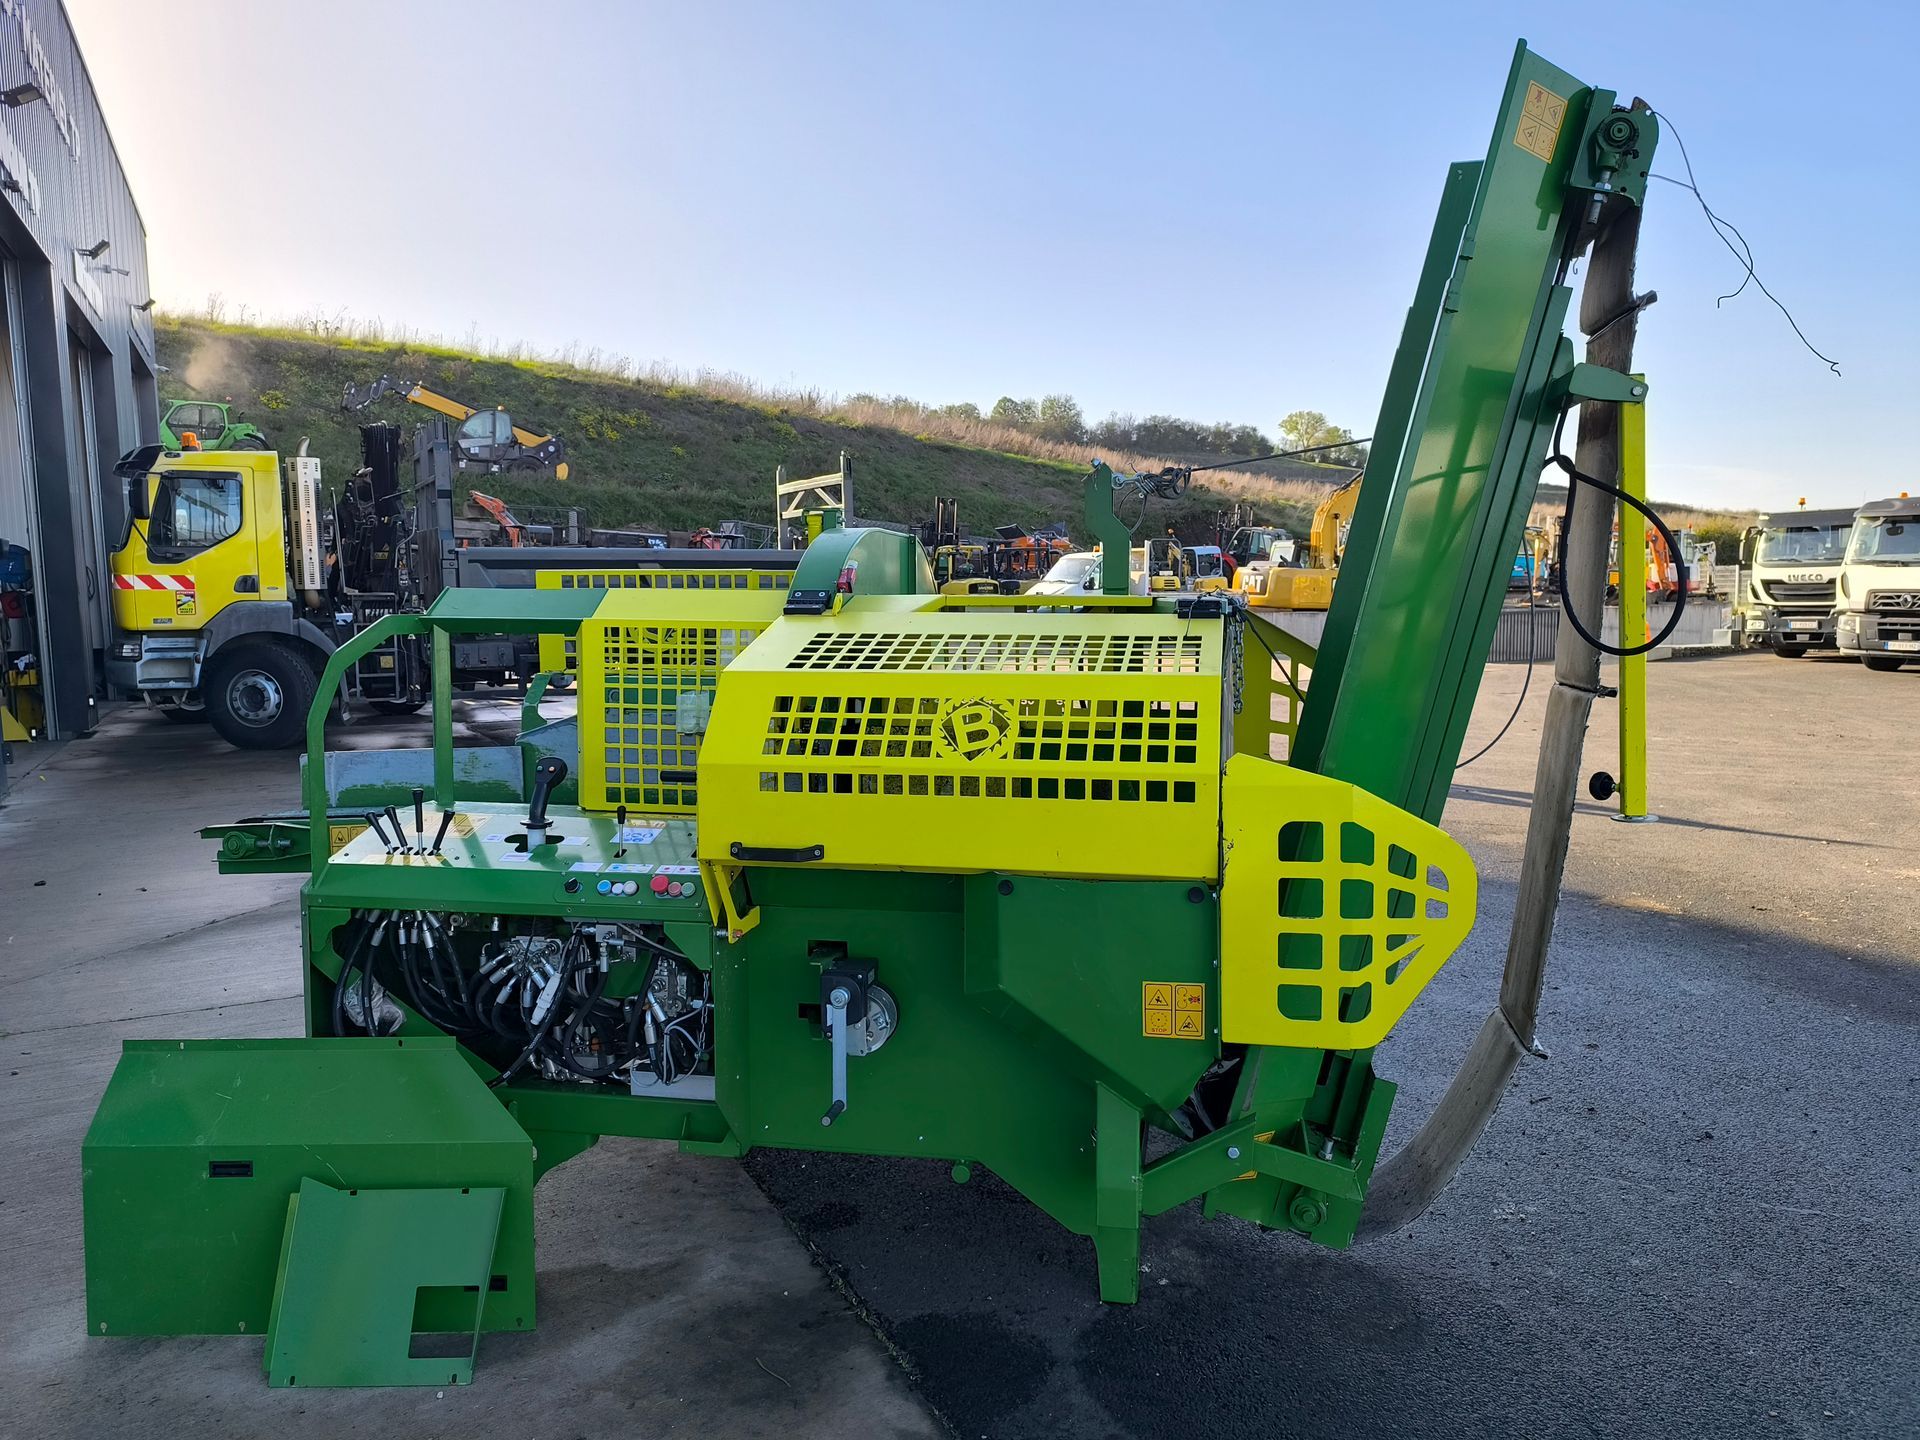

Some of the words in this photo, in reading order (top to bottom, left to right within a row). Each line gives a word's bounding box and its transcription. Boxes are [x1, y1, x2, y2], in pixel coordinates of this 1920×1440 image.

[1241, 575, 1264, 593] CAT
[1787, 573, 1824, 582] IVECO
[951, 705, 1000, 753] B
